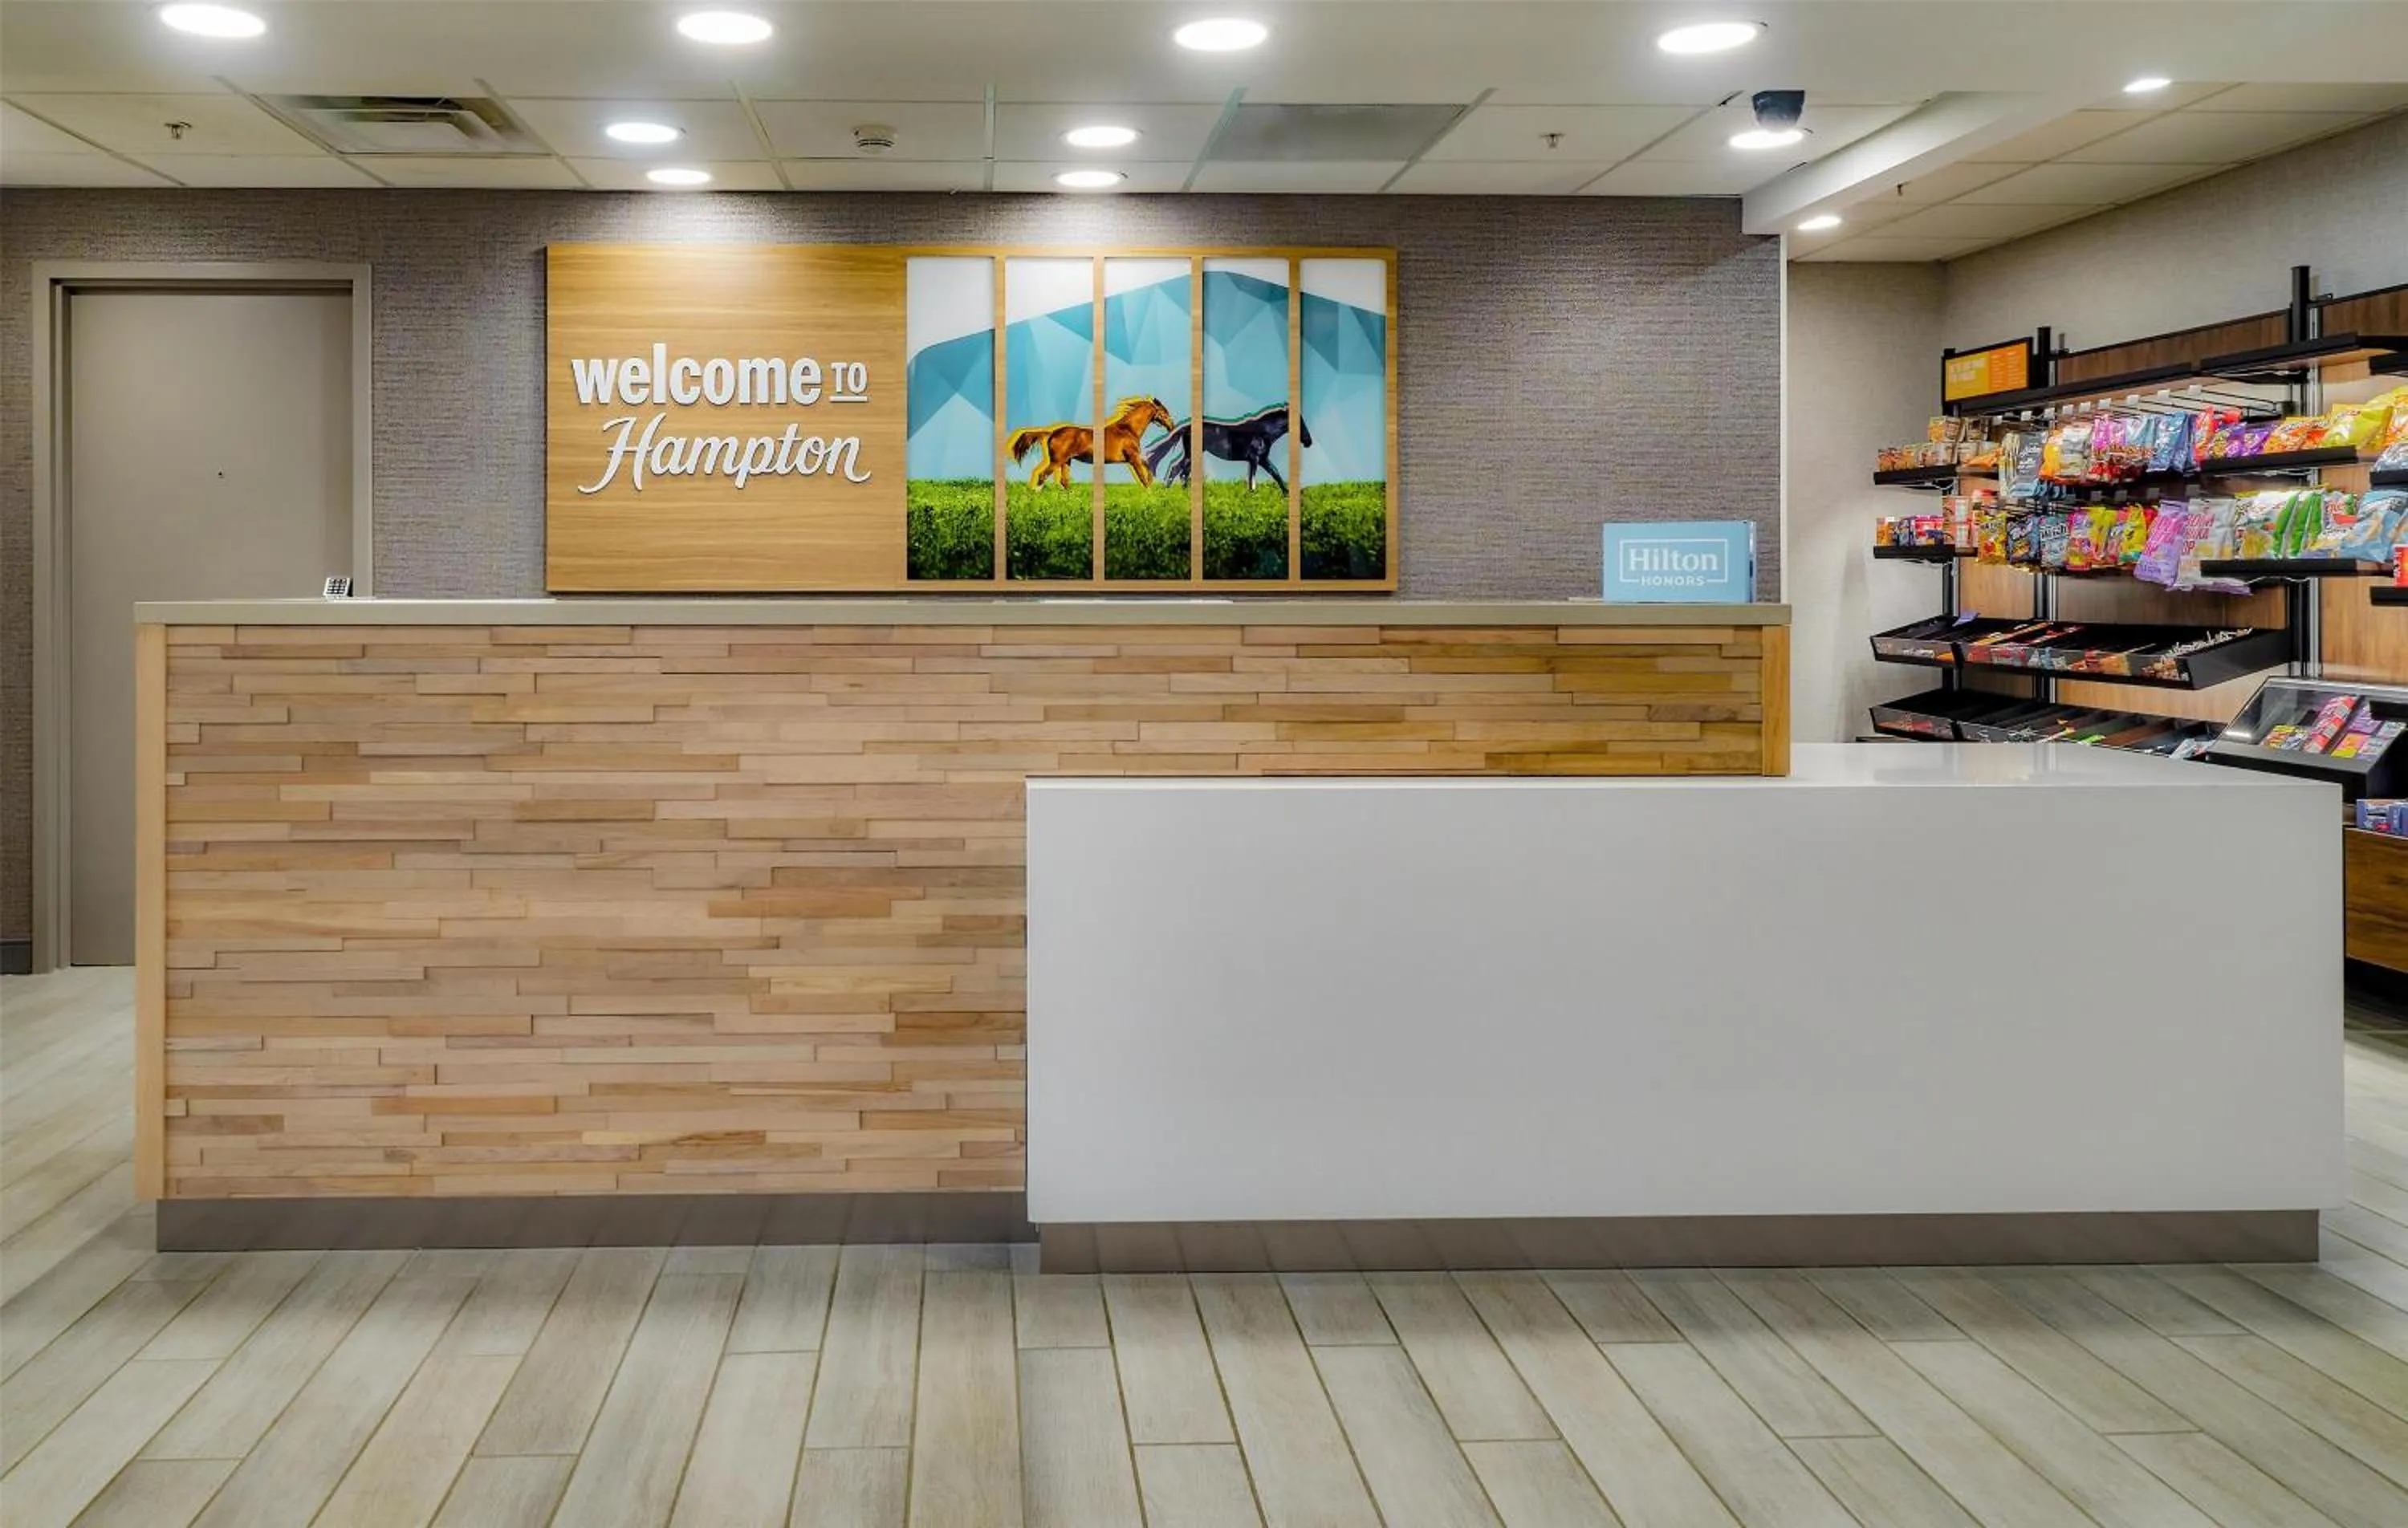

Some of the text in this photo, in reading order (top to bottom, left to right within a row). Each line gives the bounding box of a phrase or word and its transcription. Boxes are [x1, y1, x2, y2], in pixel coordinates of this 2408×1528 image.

[571, 343, 868, 405] welcome TO
[577, 412, 872, 494] Hampton
[1629, 547, 1718, 571] Hilton
[1641, 575, 1706, 586] HONORS
